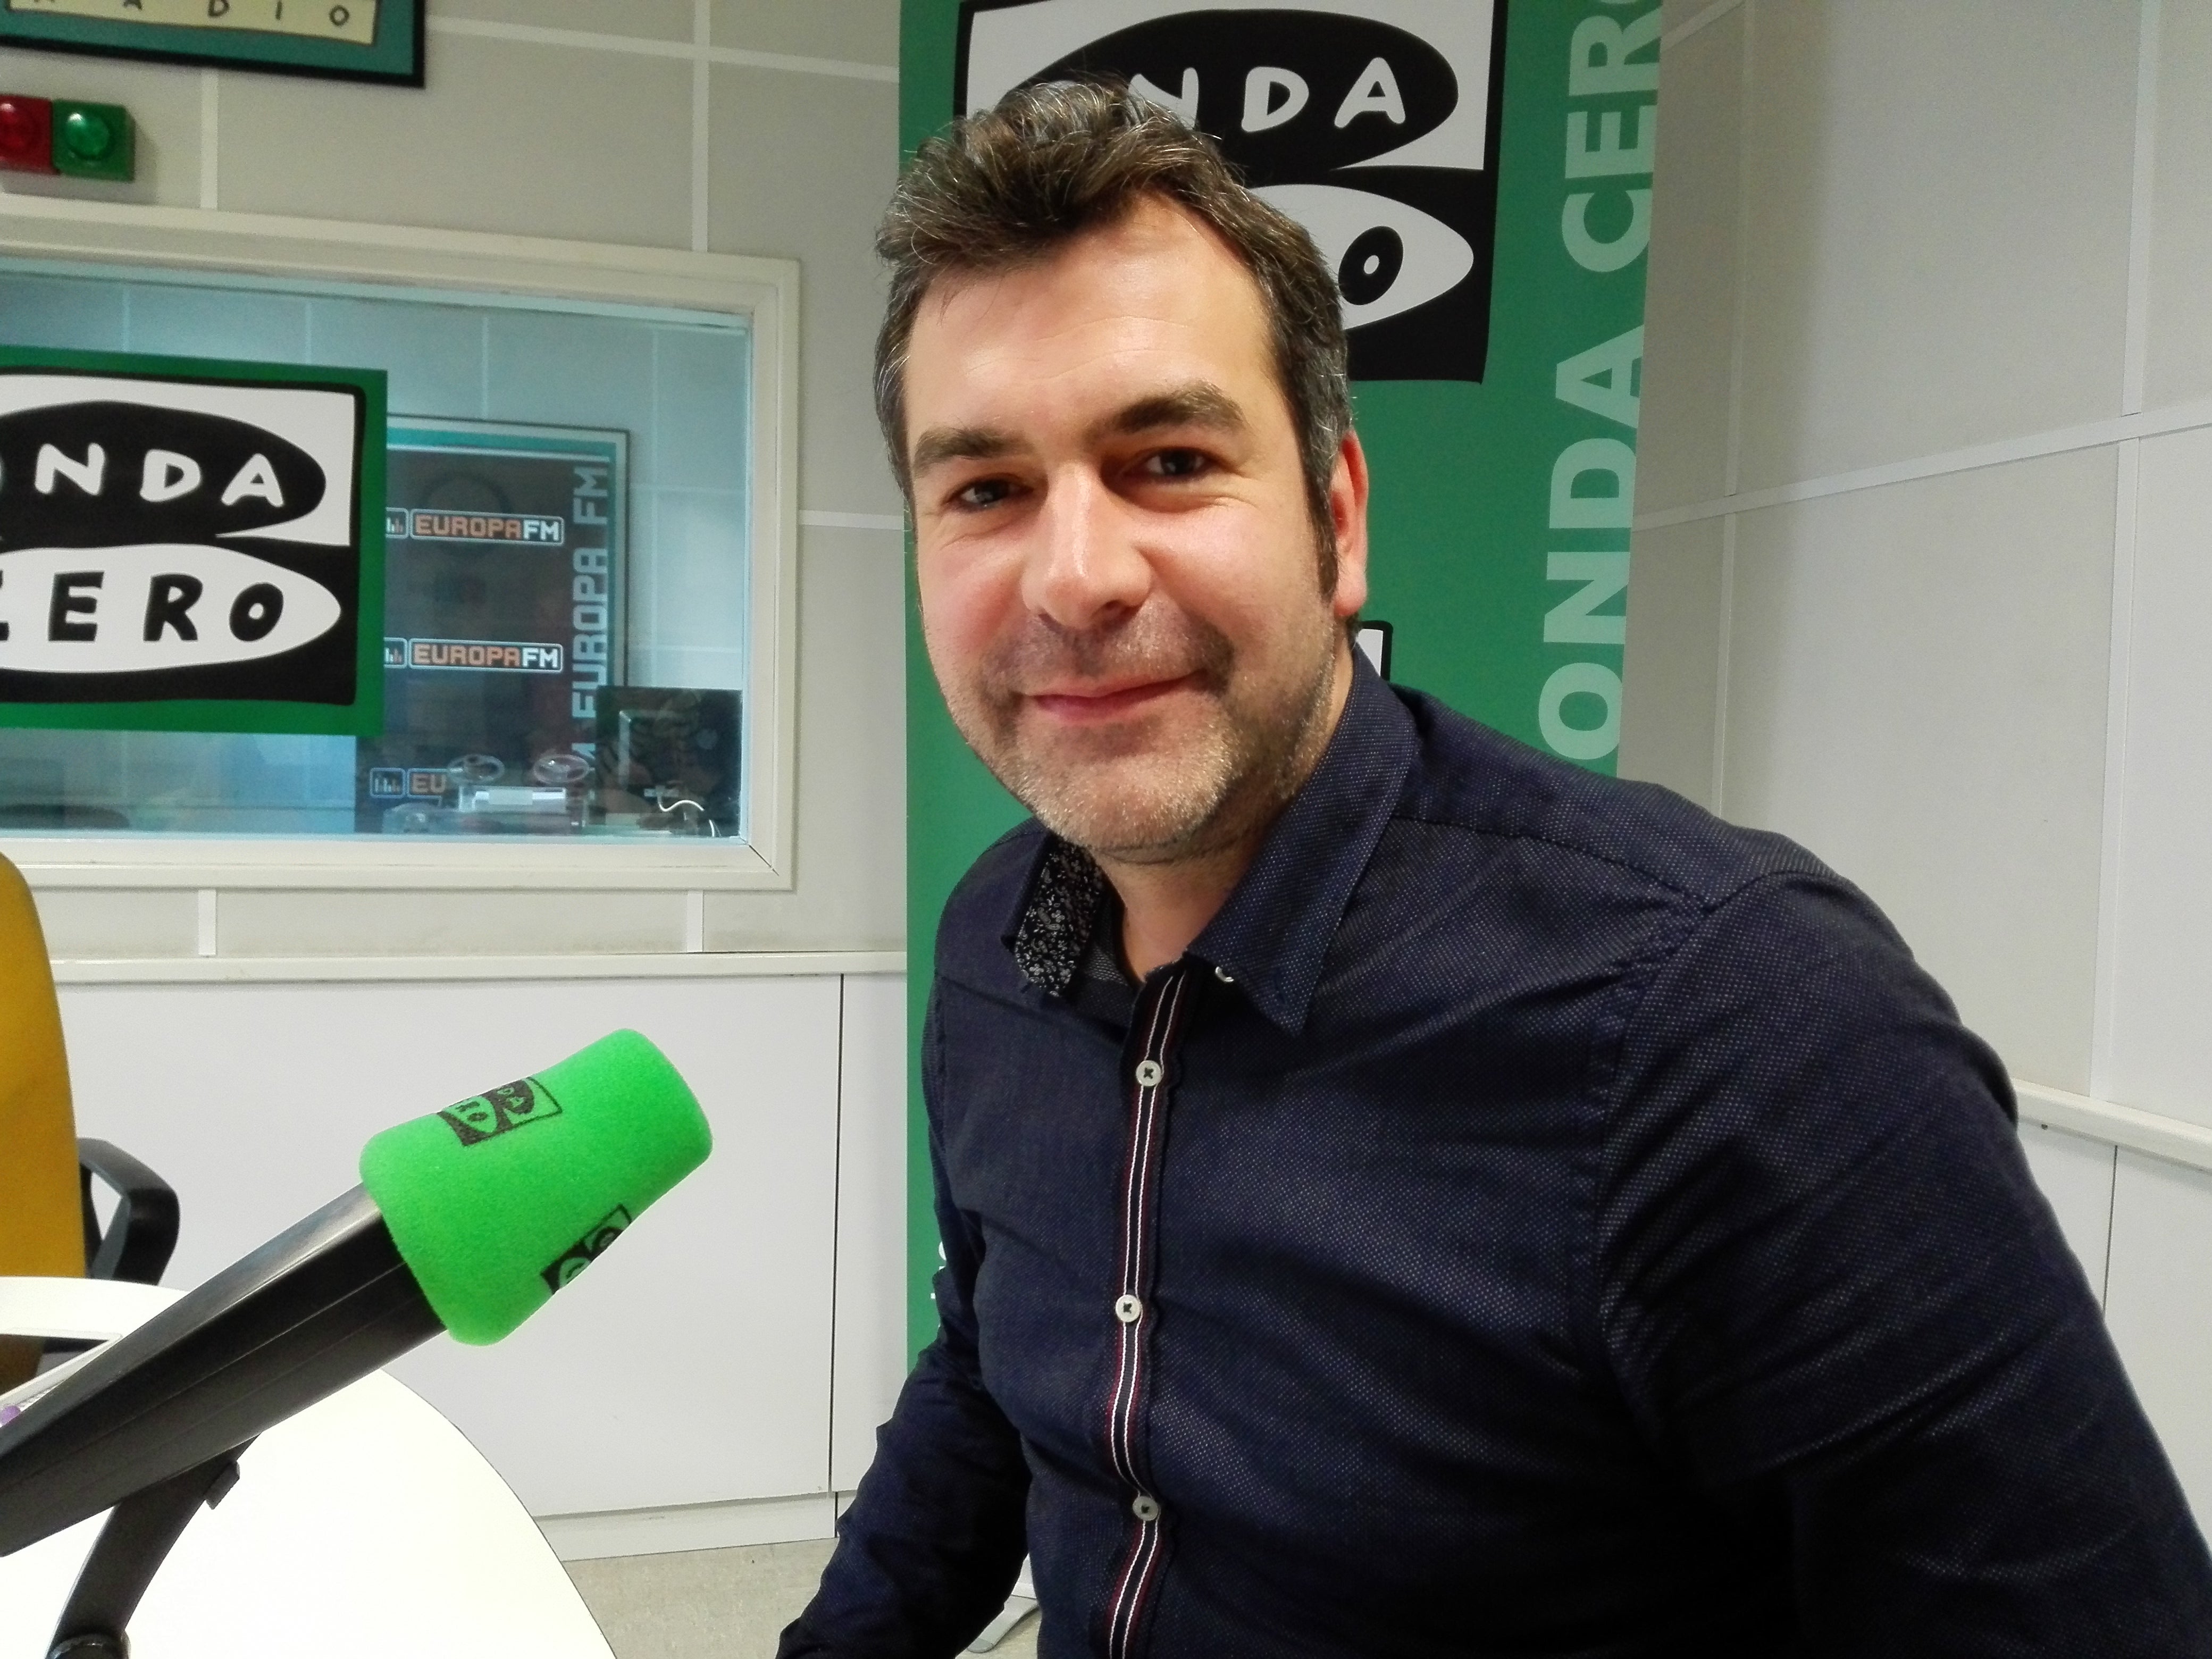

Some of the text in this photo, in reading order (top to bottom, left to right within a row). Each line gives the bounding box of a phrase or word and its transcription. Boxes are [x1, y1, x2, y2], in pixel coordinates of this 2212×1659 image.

[1128, 57, 1406, 133] NDA
[1538, 0, 1663, 760] ONDA CER
[0, 443, 284, 508] NDA
[573, 466, 608, 525] FM
[0, 569, 284, 642] ERO
